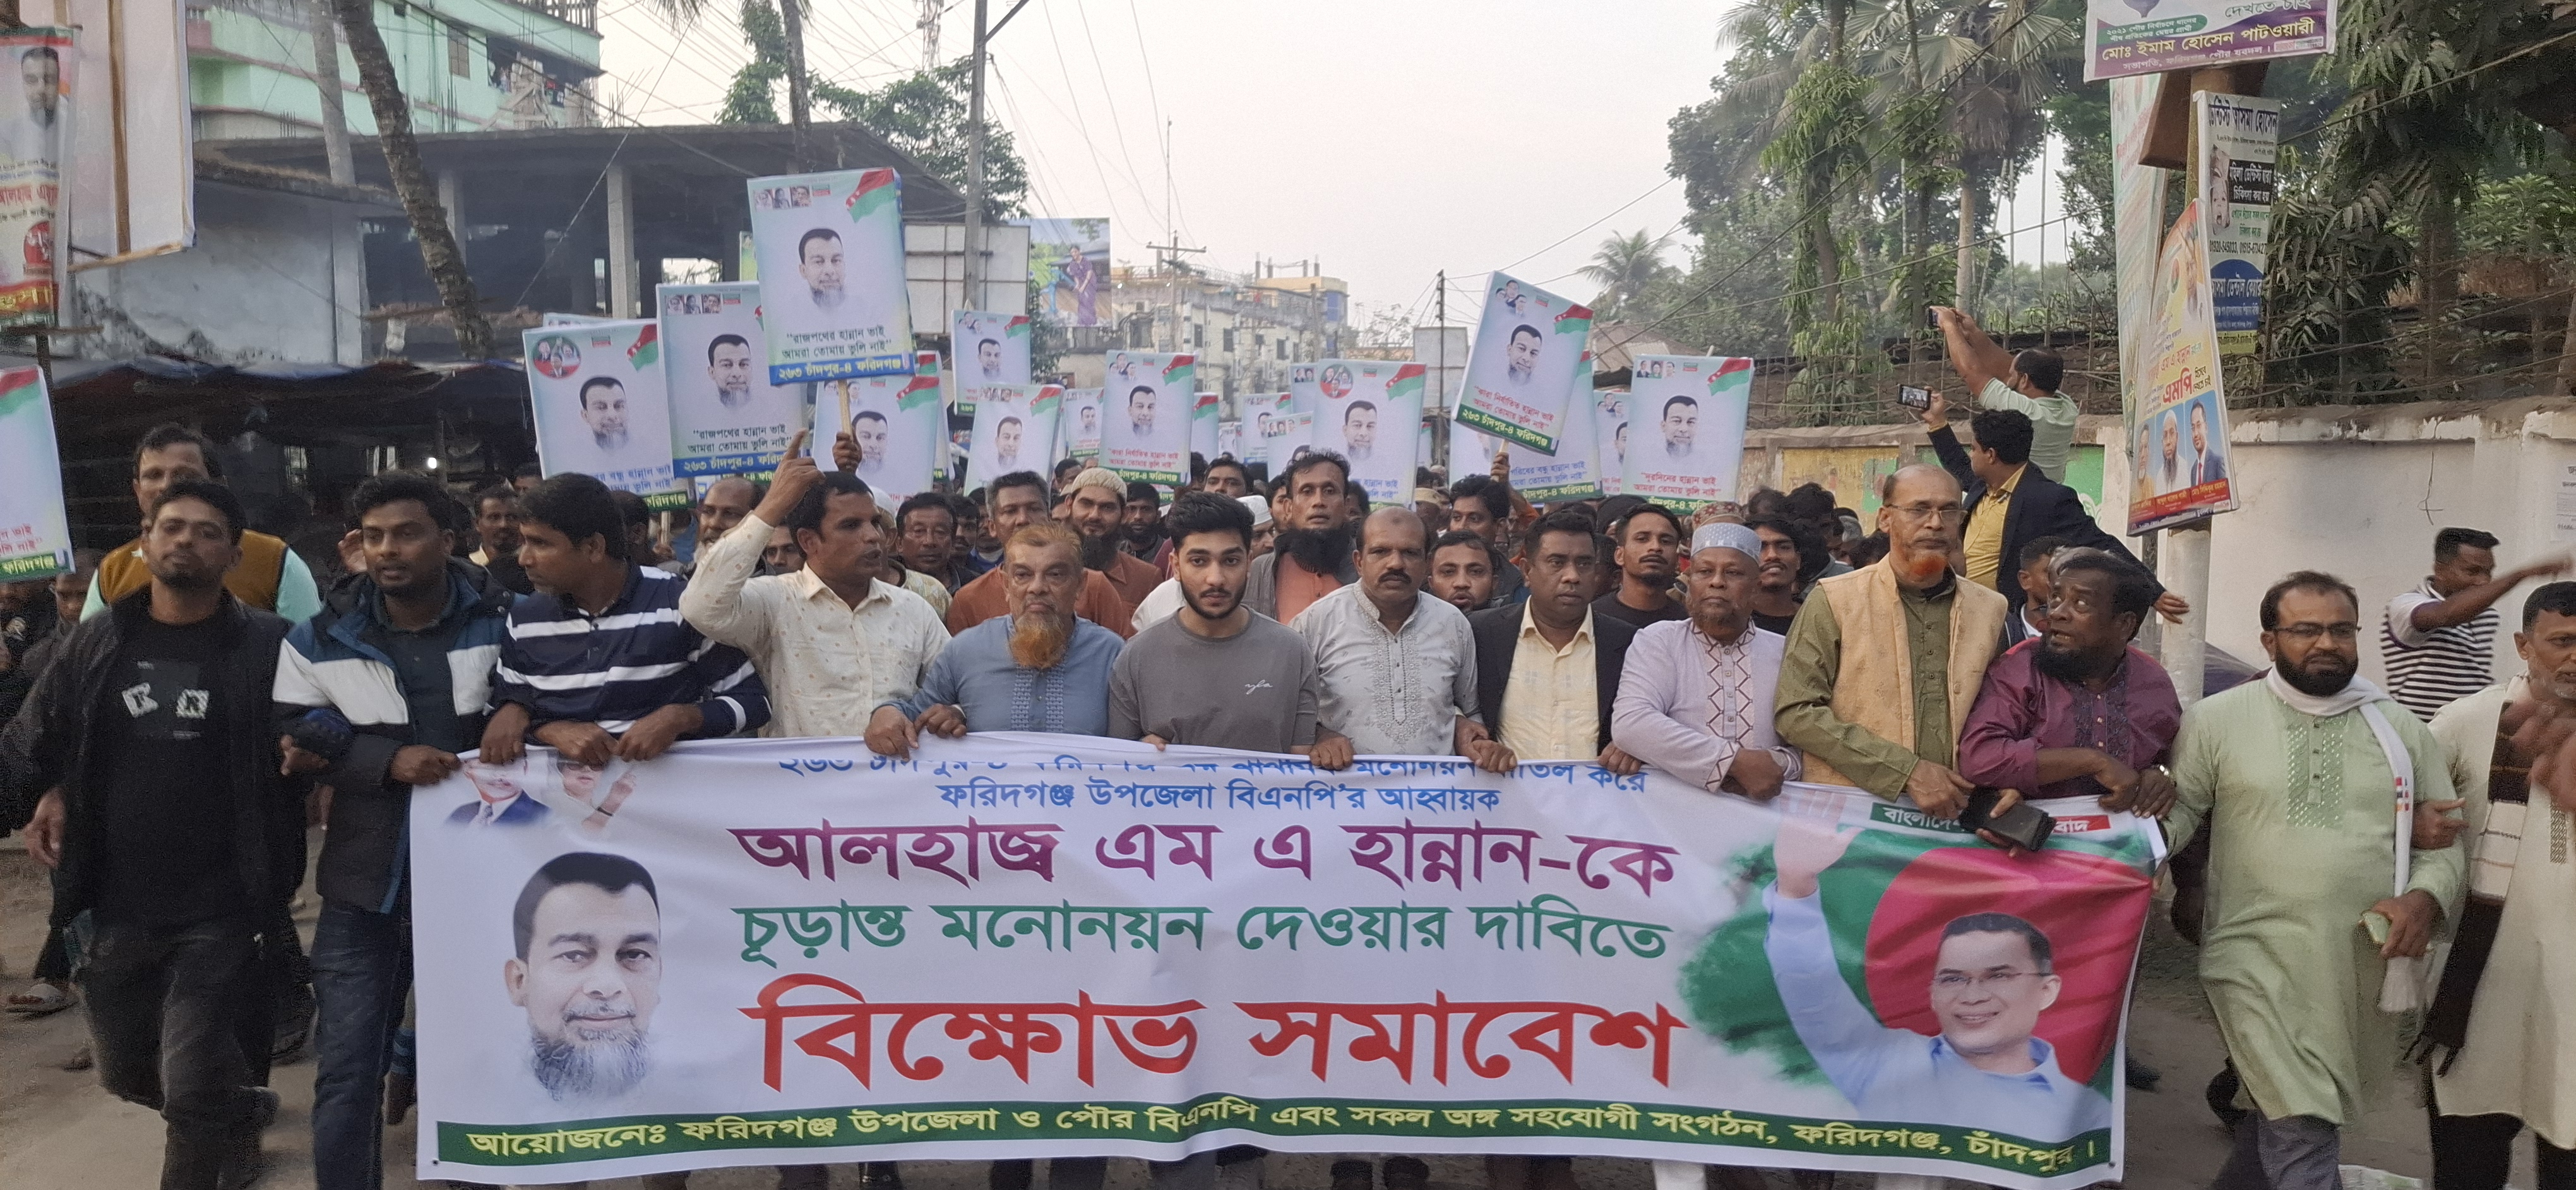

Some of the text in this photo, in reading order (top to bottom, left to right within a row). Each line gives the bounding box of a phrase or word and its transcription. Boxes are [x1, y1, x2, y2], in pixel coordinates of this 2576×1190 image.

[2225, 1, 2275, 18] দেখতে
[2102, 16, 2315, 61] মোঃ ইমাম হোসেন পাটওয়ারী
[867, 325, 886, 338] ভাই
[782, 348, 809, 361] আমরা
[814, 345, 845, 358] তোমায়
[778, 367, 802, 380] ২৬৩
[2162, 367, 2192, 404] এমপি
[1462, 409, 1480, 420] ২৬৩
[769, 423, 786, 435] ভাই
[687, 442, 715, 454] আমরা
[718, 440, 748, 453] তোমায়
[684, 460, 707, 472] ২৬৩
[935, 776, 1075, 809] ফরিদগঞ্জ
[1085, 776, 1213, 810] উপজেলা
[1376, 785, 1501, 815] আহ্বায়ক
[725, 815, 1681, 898] আলহাজ্ব এম এ হান্নান-কে
[730, 892, 1674, 970] চূড়ান্ত মনোনয়ন দেওয়ার দাবিতে
[737, 971, 1691, 1093] বিক্ষোভ সমাবেশ
[466, 1123, 667, 1157] আয়োজনেঃ
[676, 1115, 838, 1141] ফরিদগঞ্জ
[849, 1107, 1001, 1134] উপজেলা
[1012, 1110, 1041, 1129] ও
[1056, 1103, 1138, 1131] পৌর
[1143, 1096, 1260, 1134] বিএনপি
[1270, 1106, 1339, 1127] এবং
[1347, 1105, 1436, 1128] সকল
[1441, 1107, 1503, 1129] অঙ্গ
[1508, 1103, 1642, 1131] সহযোগী
[1648, 1109, 1778, 1145] সংগঠন,
[1788, 1122, 1952, 1155] ফরিদগঞ্জ,
[1964, 1129, 2077, 1172] চাঁদপুর
